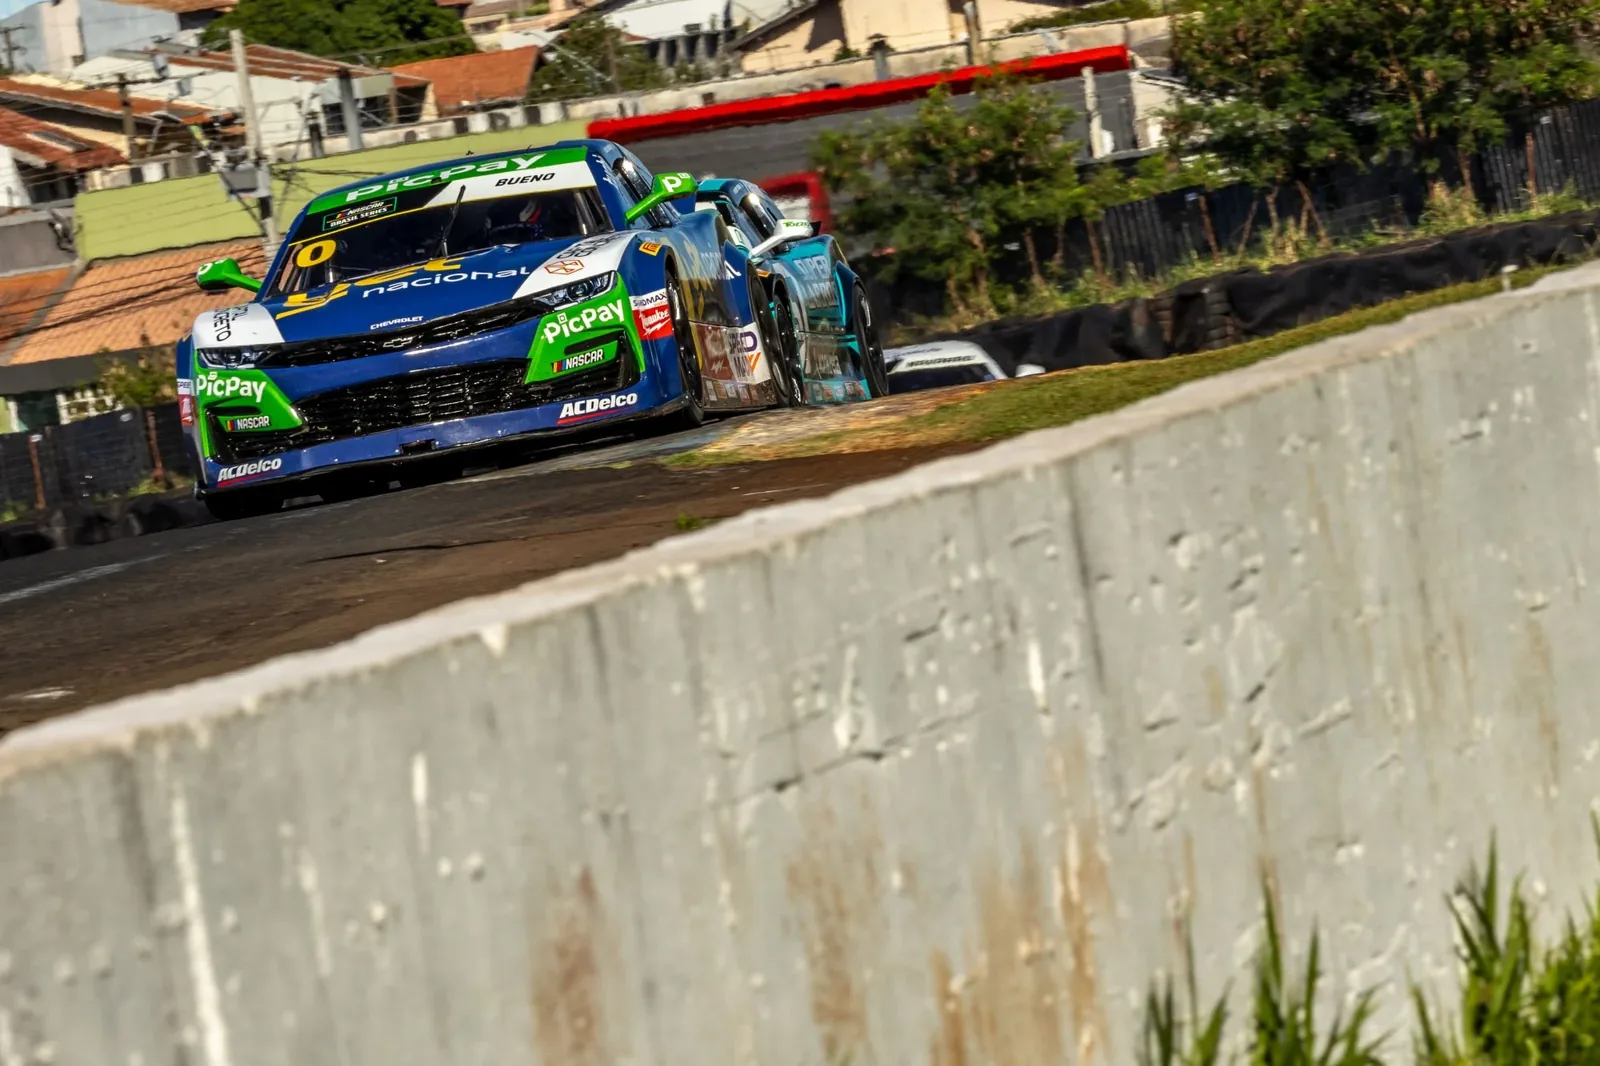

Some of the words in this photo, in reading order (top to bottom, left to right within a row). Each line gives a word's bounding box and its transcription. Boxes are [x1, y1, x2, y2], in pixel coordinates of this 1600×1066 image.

[346, 153, 547, 202] PicPay
[495, 173, 555, 187] BUENO
[330, 215, 359, 228] BRASIL
[360, 207, 388, 219] SERIES
[347, 201, 385, 216] NASCAR
[362, 266, 531, 298] nacional
[370, 316, 423, 330] CHEVROLET
[543, 299, 625, 344] PicPay
[565, 349, 604, 370] NASCAR
[196, 372, 267, 403] PicPay
[560, 393, 638, 419] ACDelco
[237, 415, 270, 430] NASCAR
[217, 457, 282, 481] ACDelco
